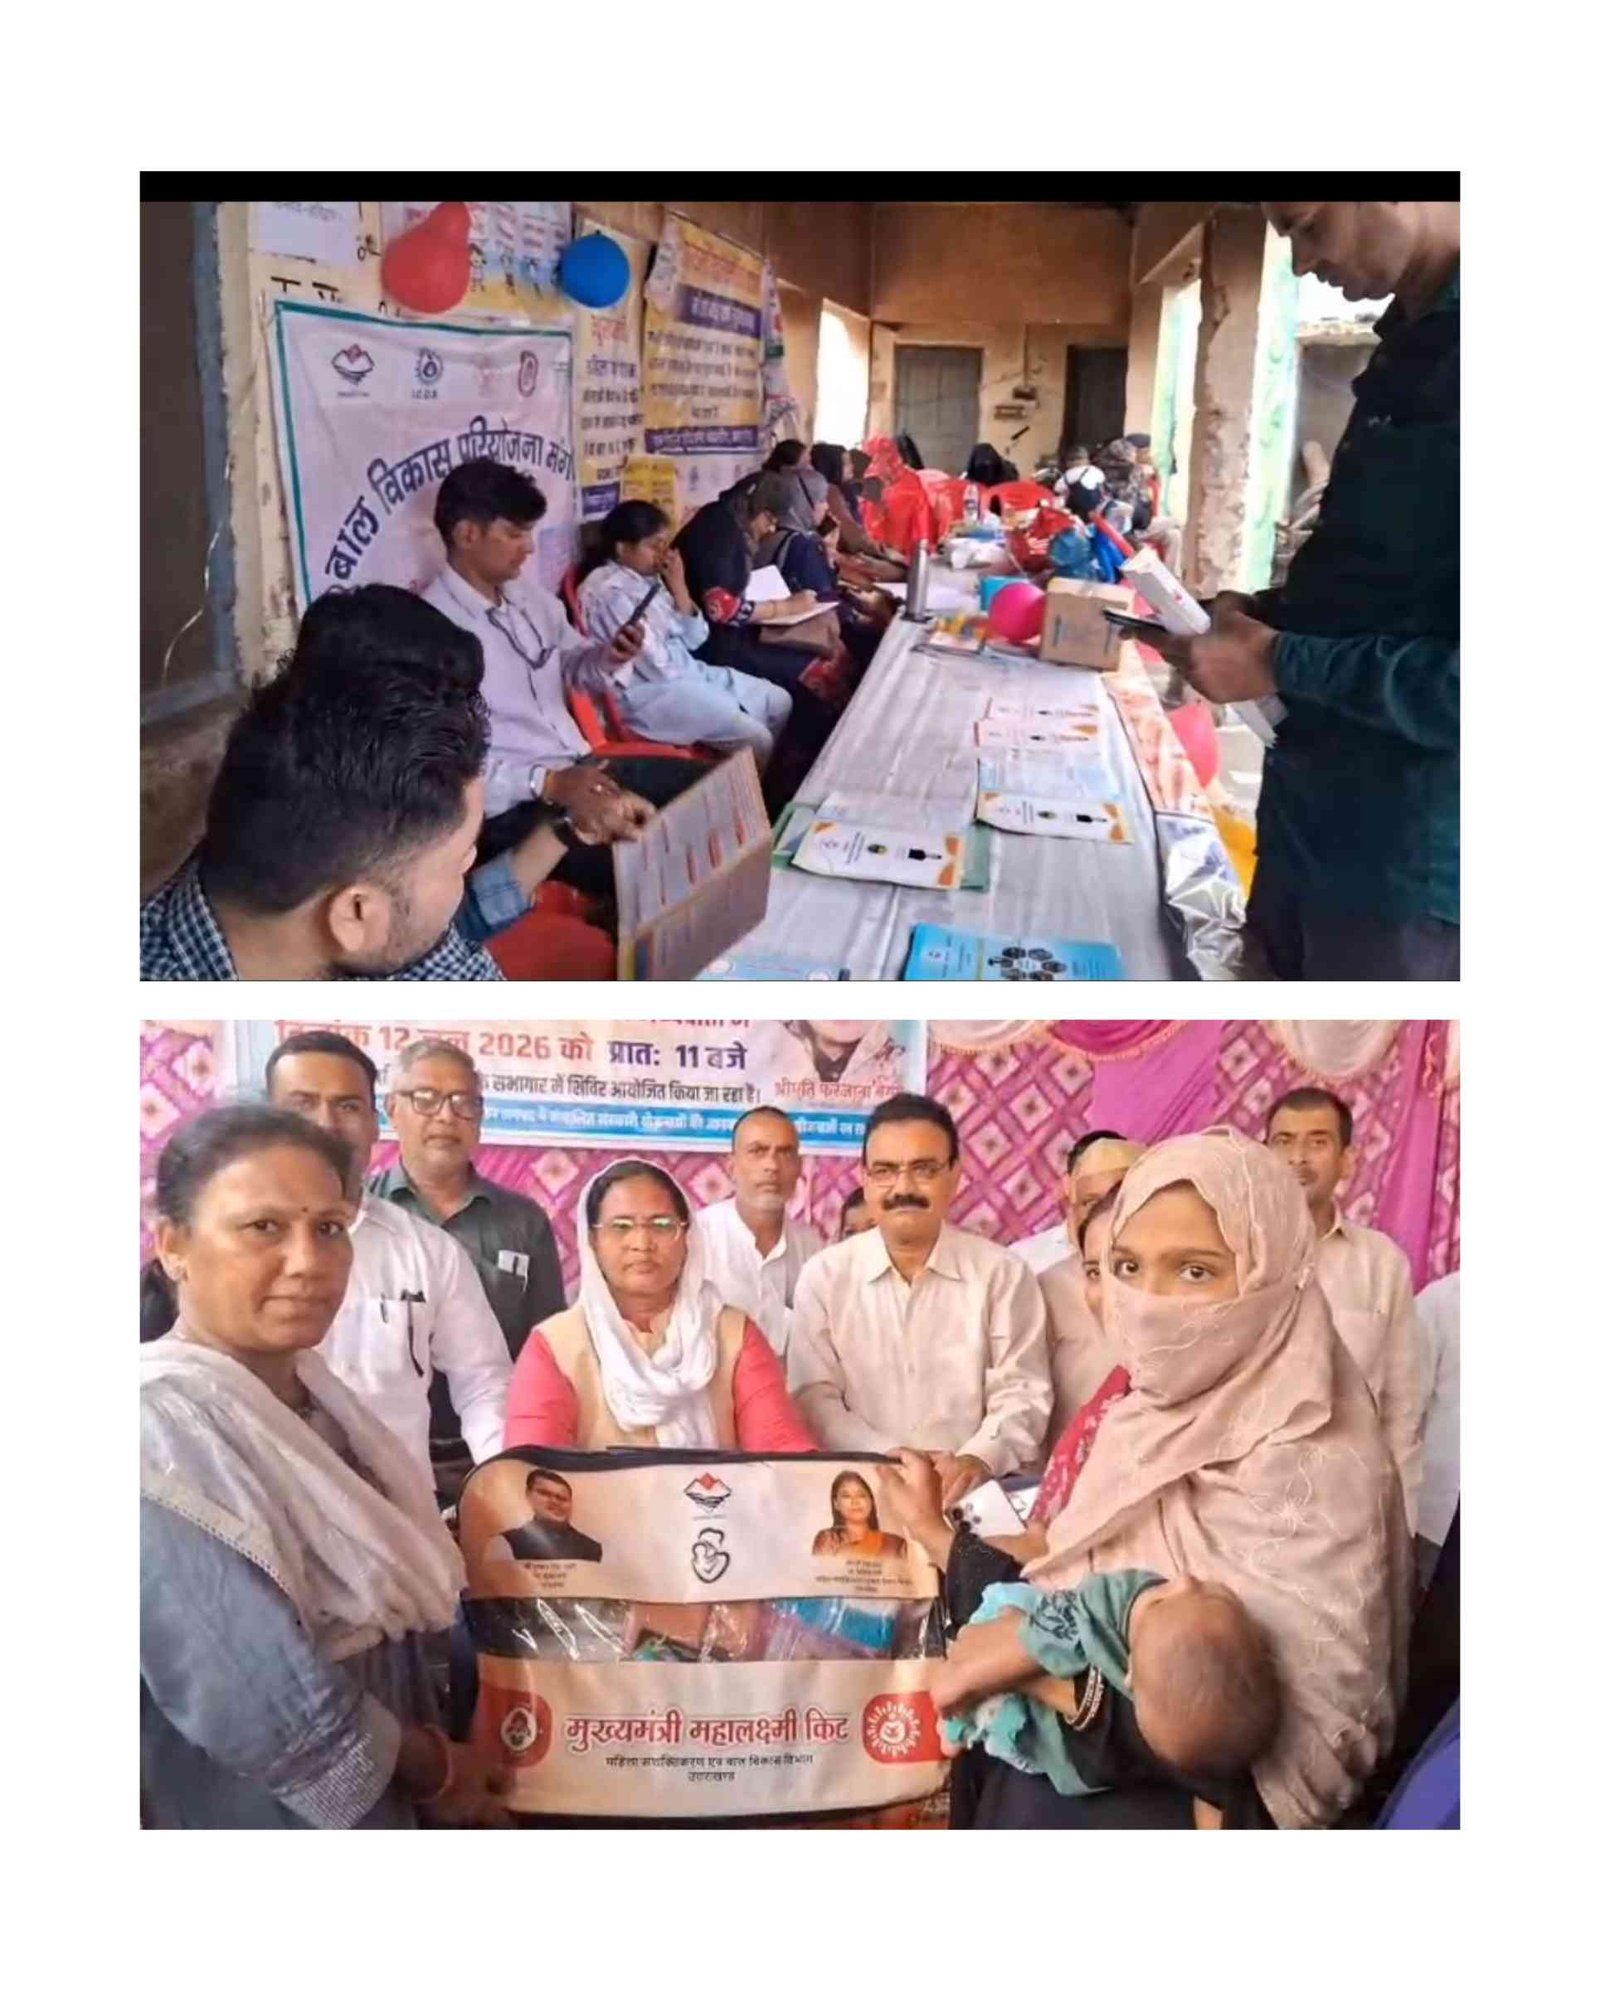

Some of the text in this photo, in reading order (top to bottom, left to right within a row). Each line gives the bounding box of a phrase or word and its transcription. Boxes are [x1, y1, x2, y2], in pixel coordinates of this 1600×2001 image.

[325, 415, 576, 580] बाल विकास परियोजना मंग
[379, 1027, 410, 1051] 12
[479, 1032, 551, 1061] 2026
[558, 1031, 594, 1062] को
[675, 1044, 699, 1068] 11
[704, 1041, 748, 1070] बजे
[492, 1074, 547, 1094] सभागार
[550, 1073, 565, 1095] में
[567, 1075, 607, 1098] शिविर
[611, 1077, 665, 1101] आयोजित
[668, 1081, 700, 1102] किया
[704, 1084, 719, 1102] जा
[567, 1707, 849, 1751] मुख्यमंत्री महालक्ष्मी किट
